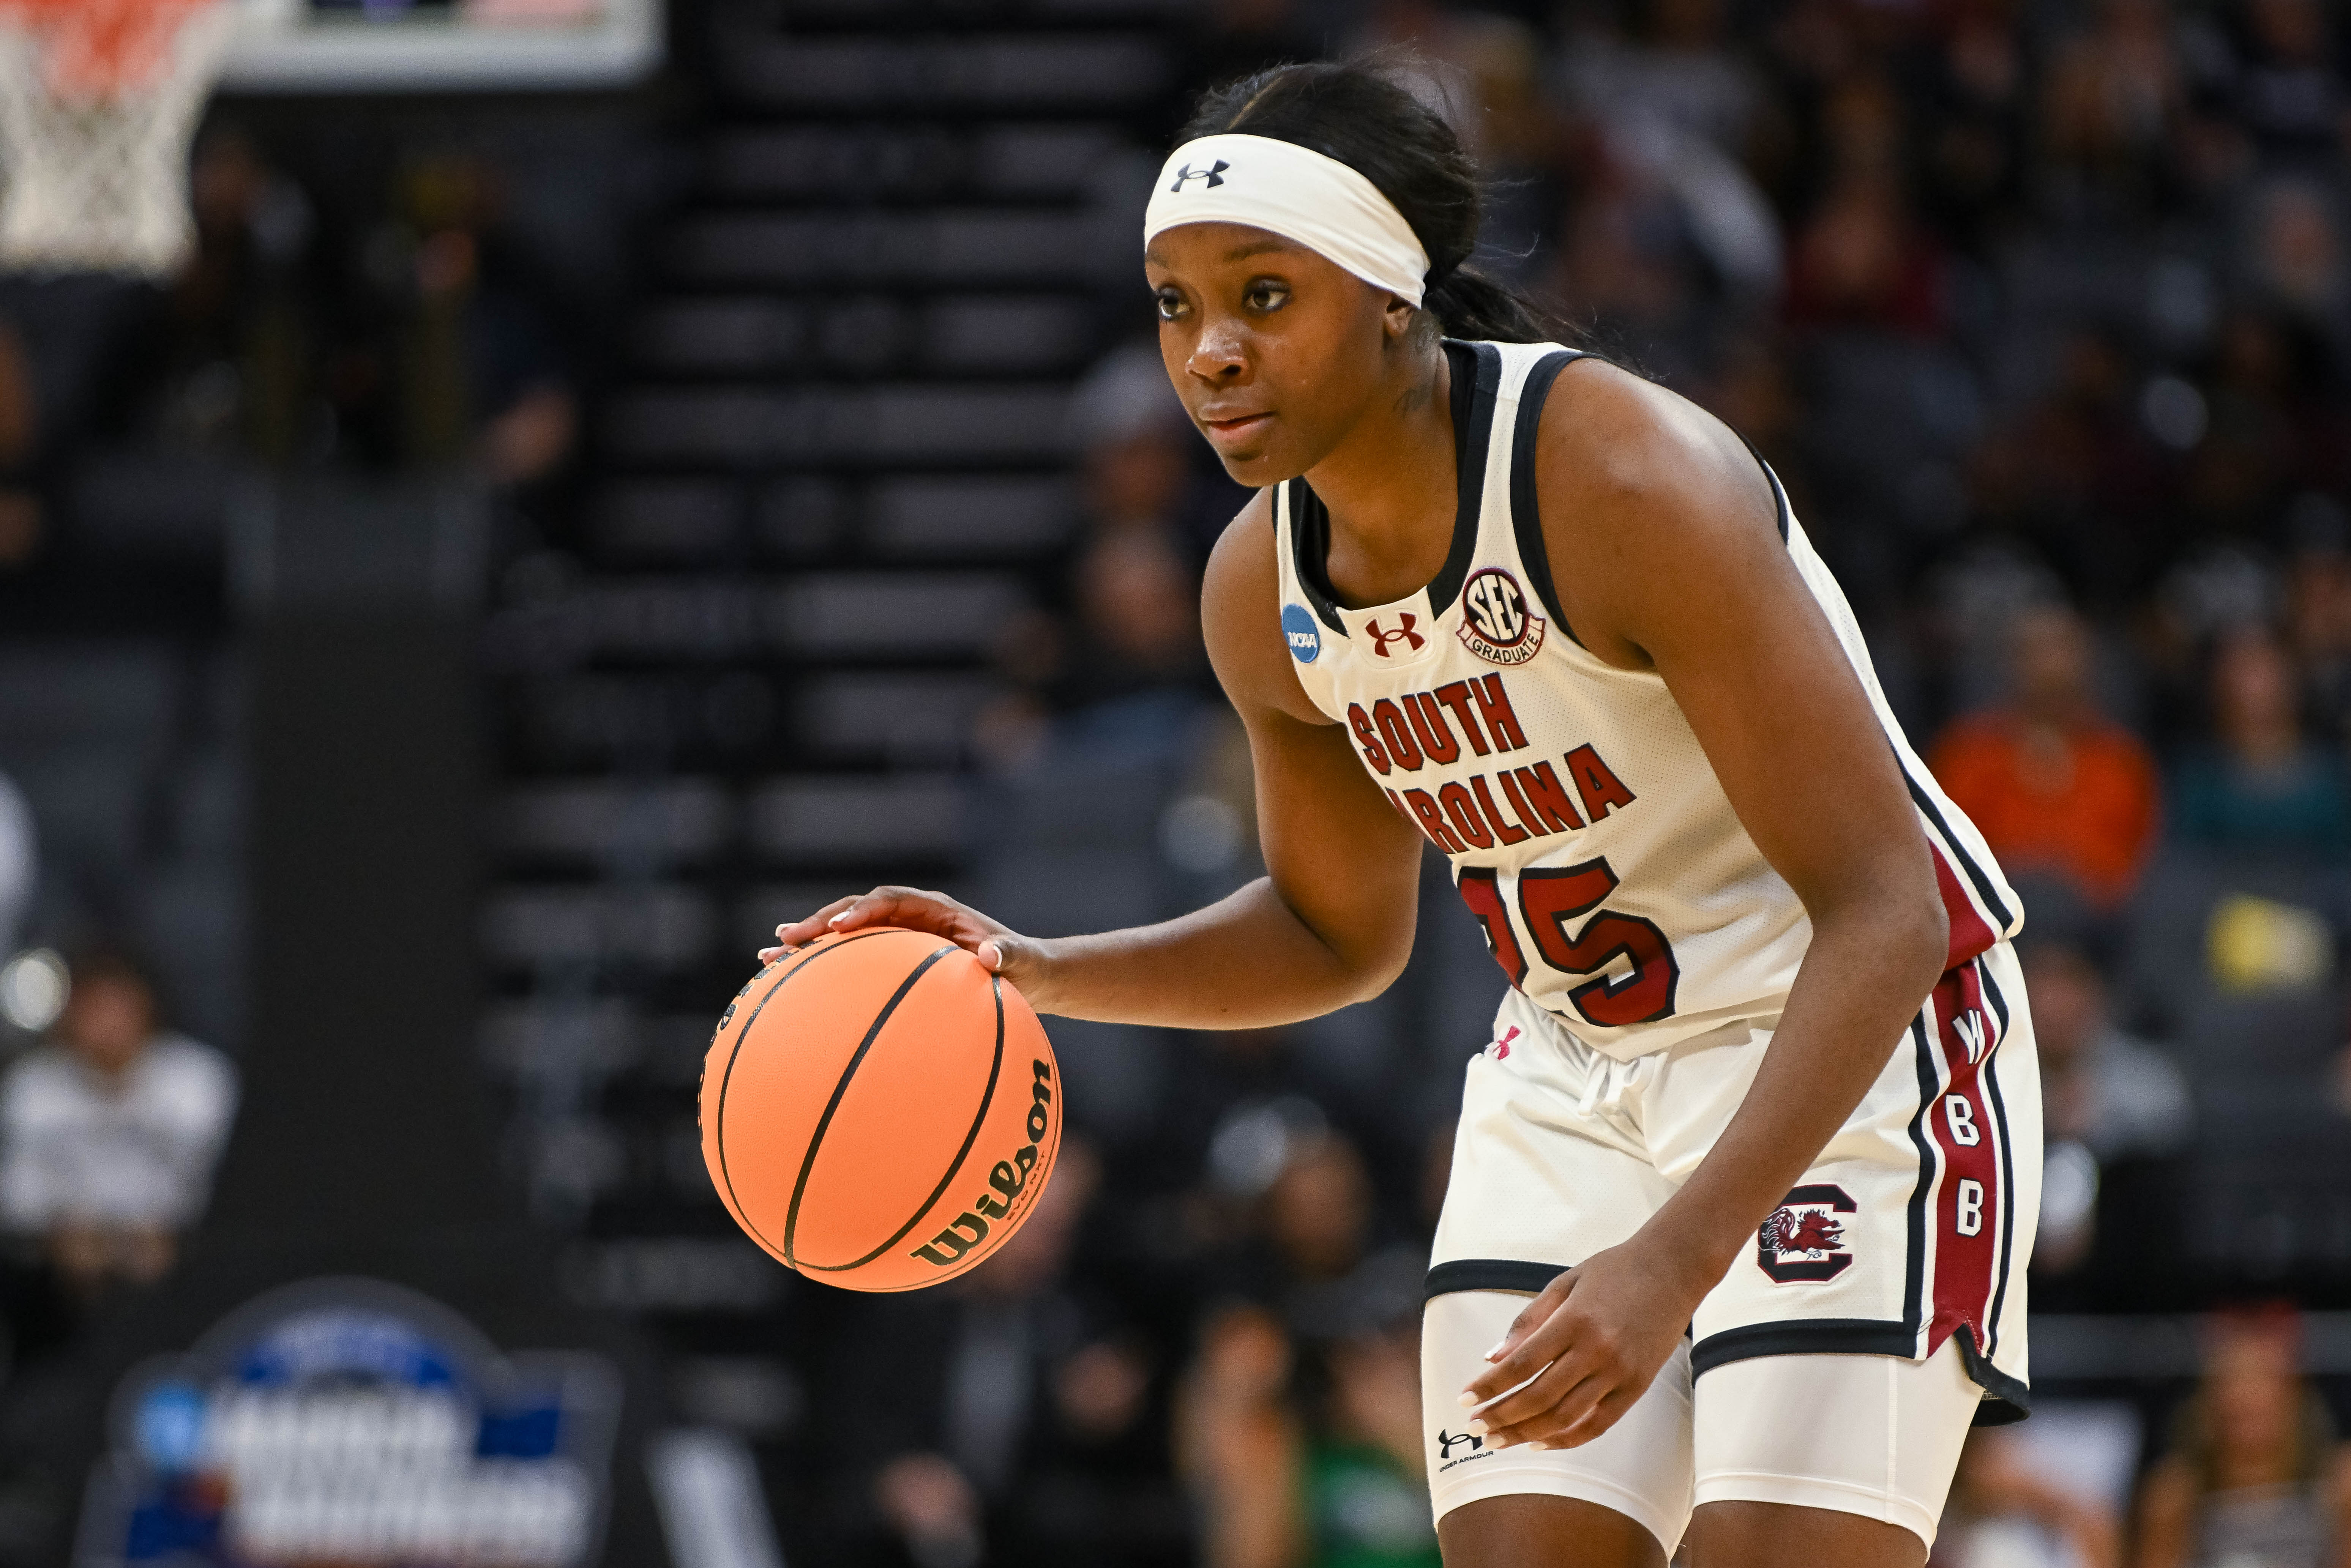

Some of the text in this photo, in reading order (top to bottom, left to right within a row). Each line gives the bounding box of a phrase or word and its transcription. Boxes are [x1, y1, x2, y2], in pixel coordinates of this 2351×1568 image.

[1288, 632, 1317, 648] NCAA
[1467, 574, 1523, 641] SEC
[1472, 633, 1539, 663] GRADUATE
[1347, 671, 1529, 776] SOUTH
[1385, 742, 1637, 855] ROLINA
[908, 1057, 1052, 1266] Wilson
[1439, 1451, 1494, 1473] UNDER ARMOUR
